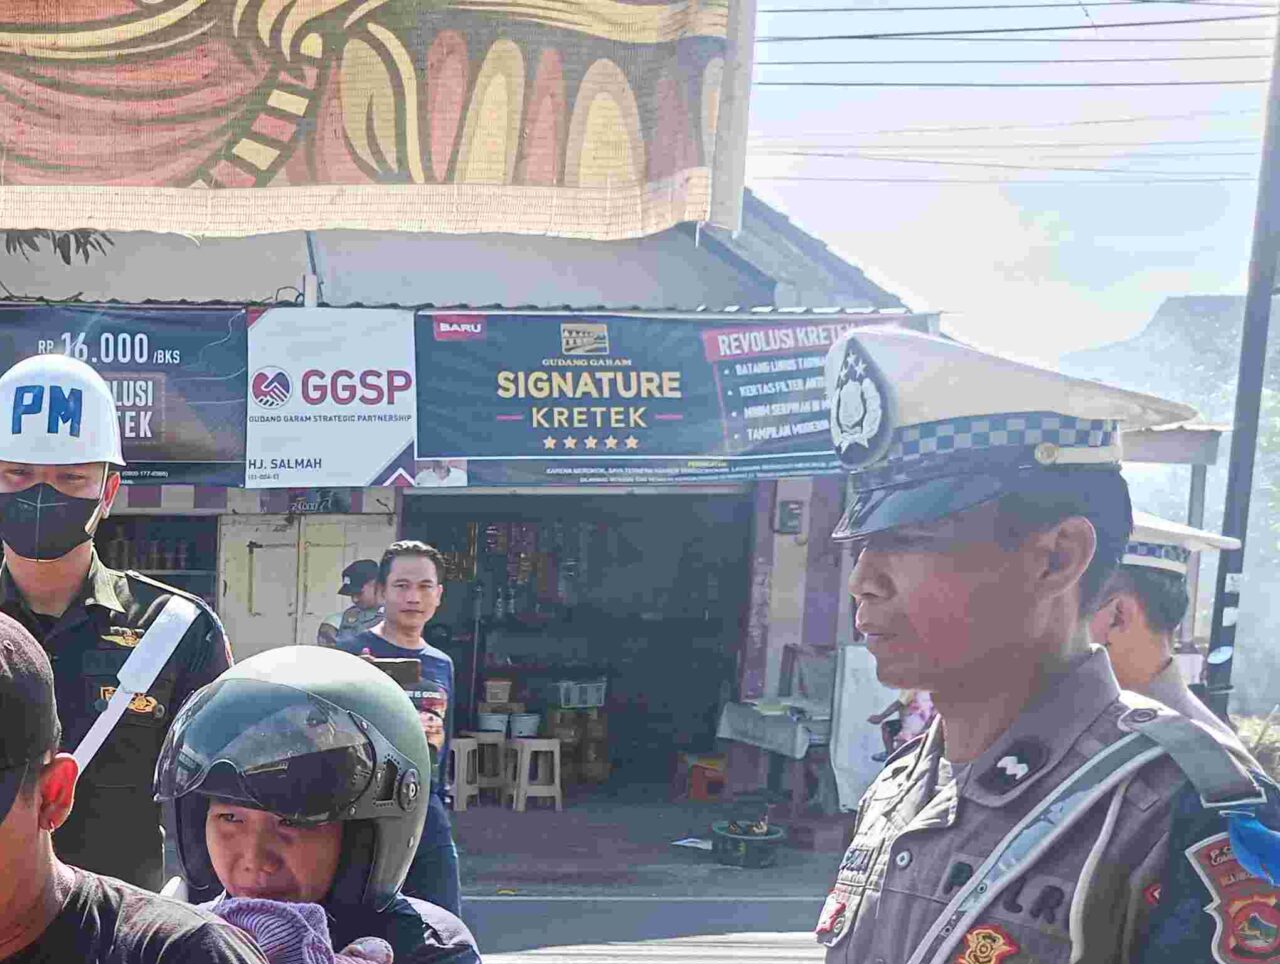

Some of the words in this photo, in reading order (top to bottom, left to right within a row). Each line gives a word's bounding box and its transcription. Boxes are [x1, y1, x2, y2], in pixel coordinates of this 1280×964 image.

[439, 322, 482, 333] BARU
[61, 332, 148, 363] 16.000
[152, 350, 180, 364] /BKS
[717, 328, 794, 356] REVOLUSI
[542, 358, 588, 366] GUDANG
[589, 358, 632, 366] GARAM
[104, 380, 154, 407] LUSI
[301, 369, 412, 405] GGSP
[496, 371, 683, 398] SIGNATURE
[11, 385, 83, 438] PM
[283, 415, 312, 423] GARAM
[313, 414, 356, 423] STRATEGIC
[357, 414, 412, 423] PARTNERSHIP
[532, 406, 648, 428] KRETEK
[248, 459, 267, 470] HJ.
[270, 458, 322, 470] SALMAH
